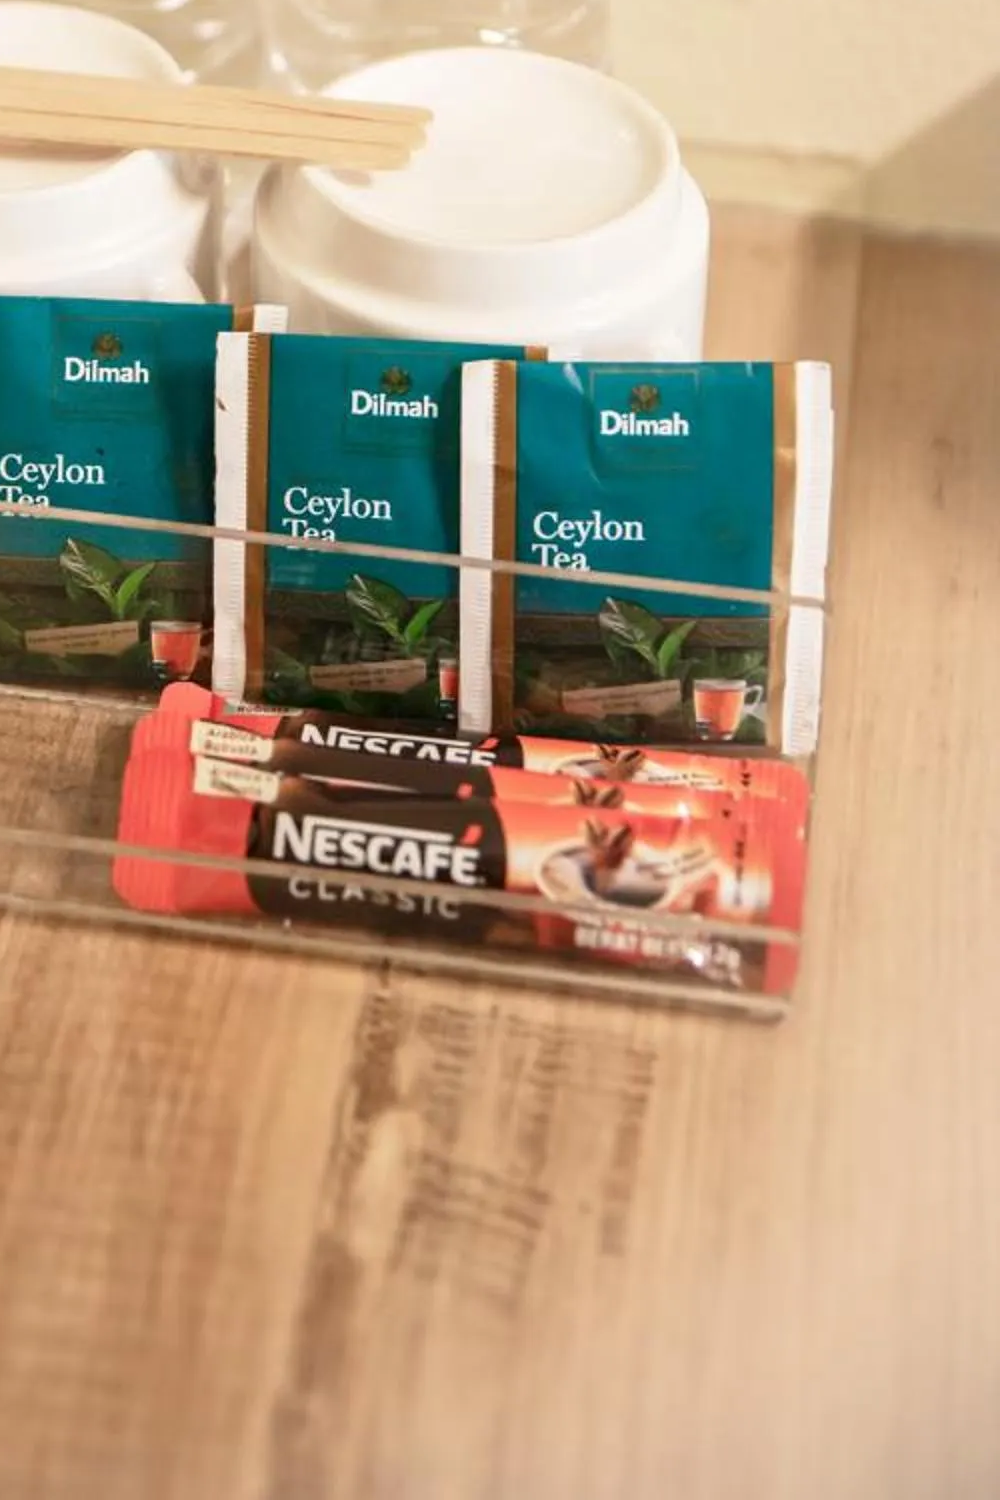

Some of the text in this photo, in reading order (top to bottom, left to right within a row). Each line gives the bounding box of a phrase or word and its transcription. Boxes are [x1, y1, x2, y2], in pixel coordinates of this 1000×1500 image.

[64, 356, 150, 384] Dilmah
[351, 389, 439, 418] Dilmah
[600, 411, 689, 436] Dilmah
[283, 487, 392, 524] Ceylon
[534, 509, 646, 548] Ceylon
[531, 543, 591, 572] Tea
[274, 811, 481, 885] NESCAFÉ
